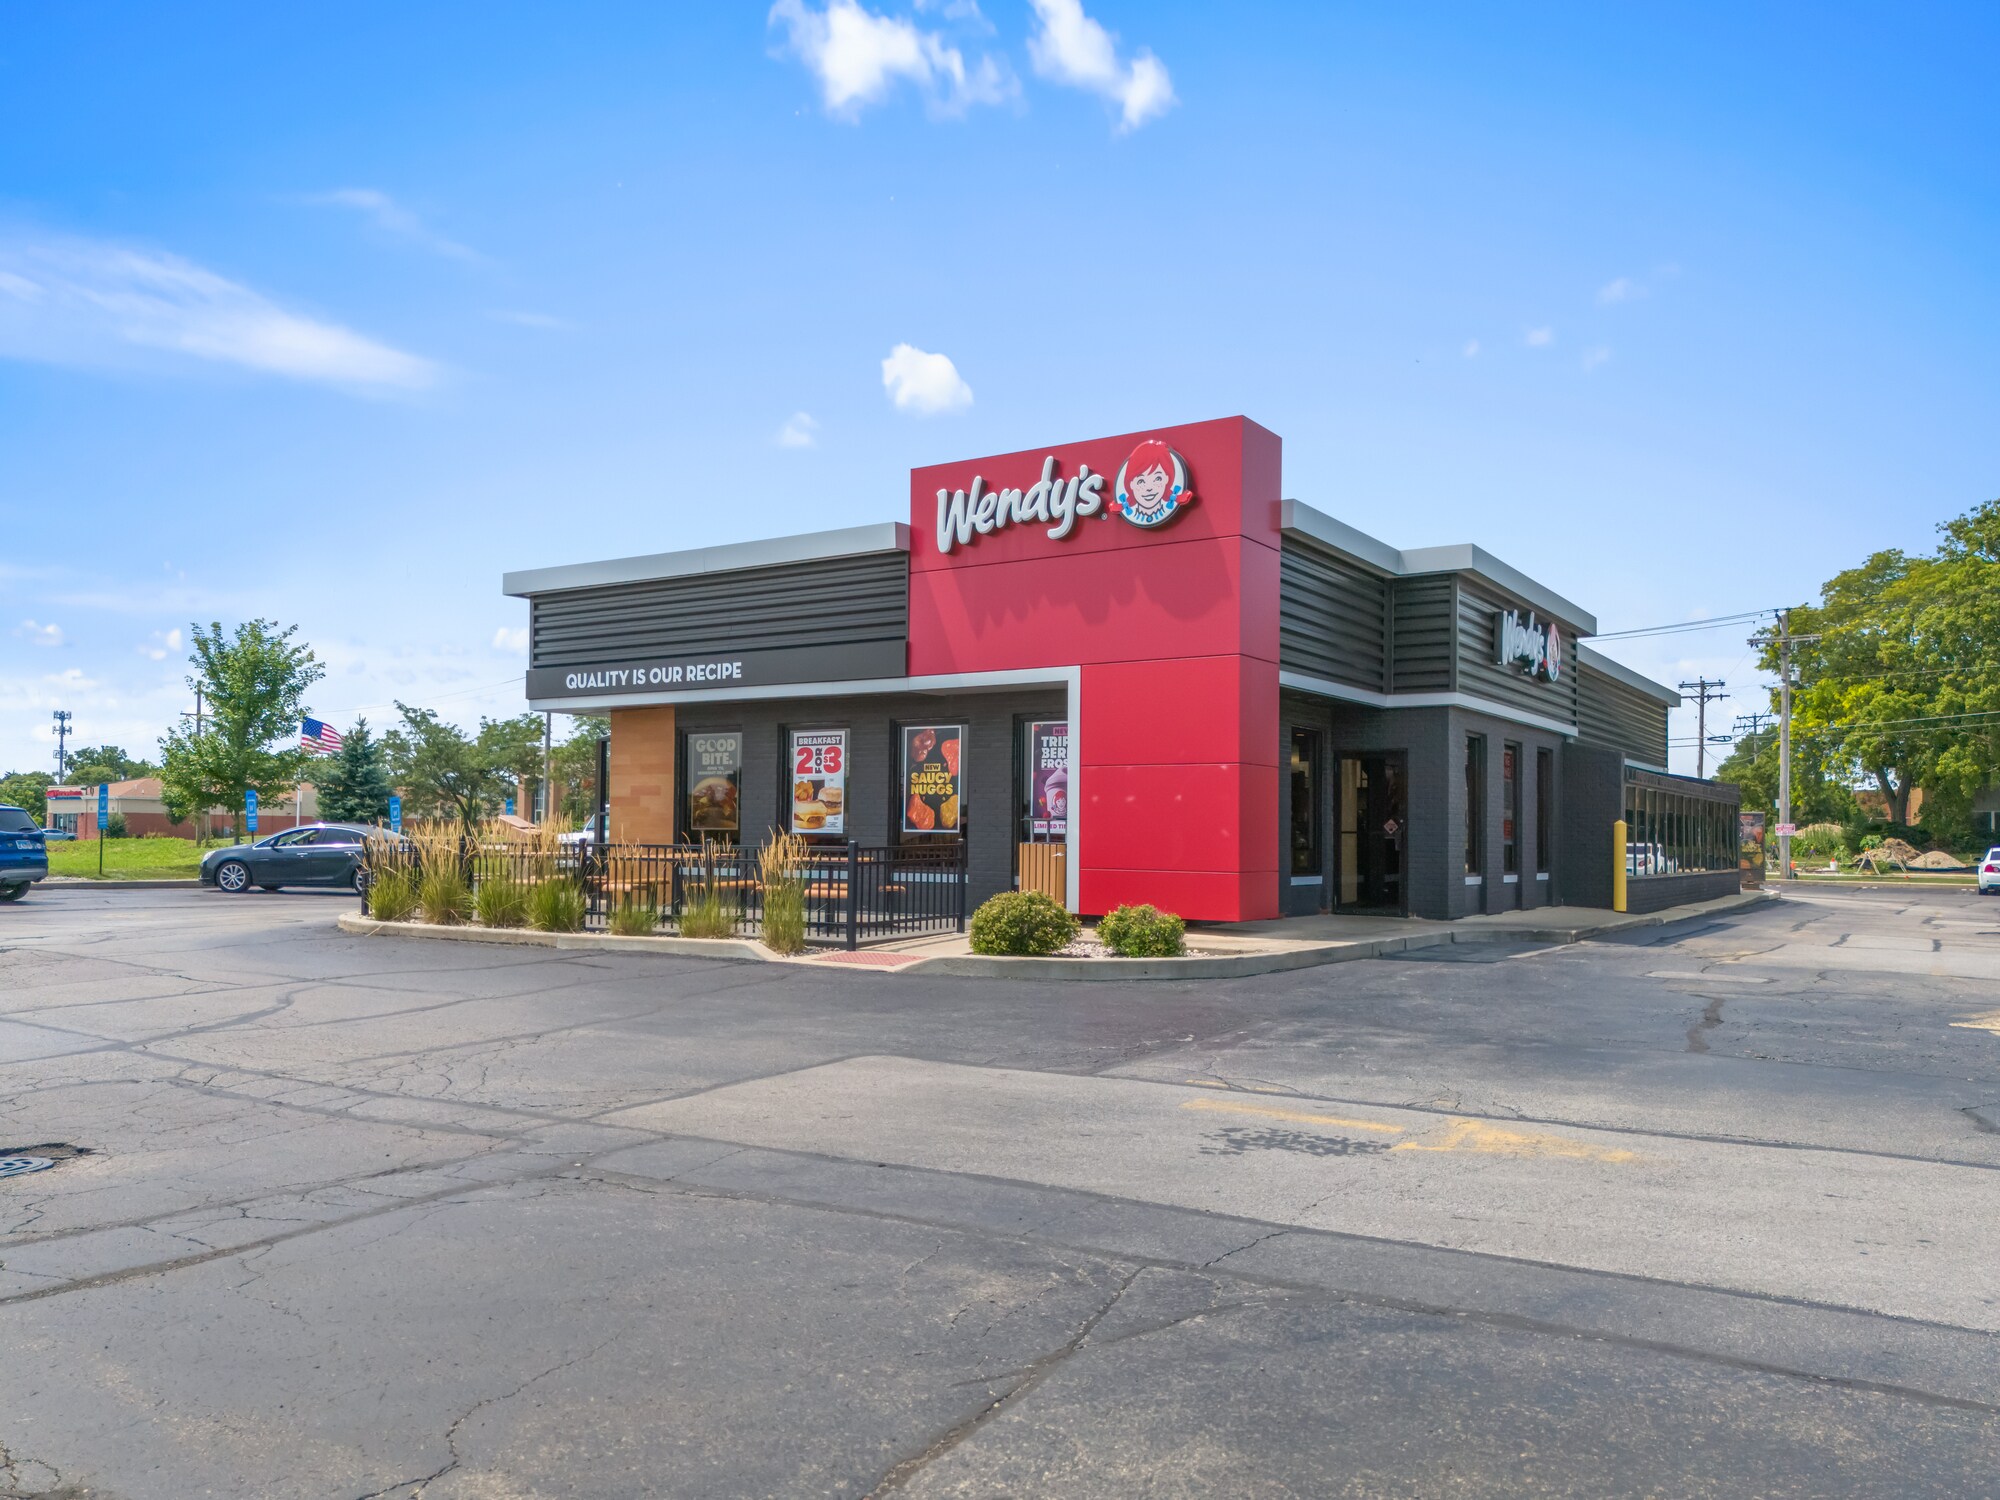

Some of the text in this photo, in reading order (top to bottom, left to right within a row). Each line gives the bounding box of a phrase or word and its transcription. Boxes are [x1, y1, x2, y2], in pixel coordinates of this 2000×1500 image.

[937, 456, 1104, 553] Wendy's
[566, 662, 742, 689] QUALITY IS OUR RECIPE
[696, 739, 736, 752] GOOD
[798, 737, 841, 745] BREAKFAST
[702, 752, 733, 765] BITE.
[1041, 747, 1068, 759] BER
[911, 772, 952, 783] SAUCY
[911, 783, 953, 795] NUGGS
